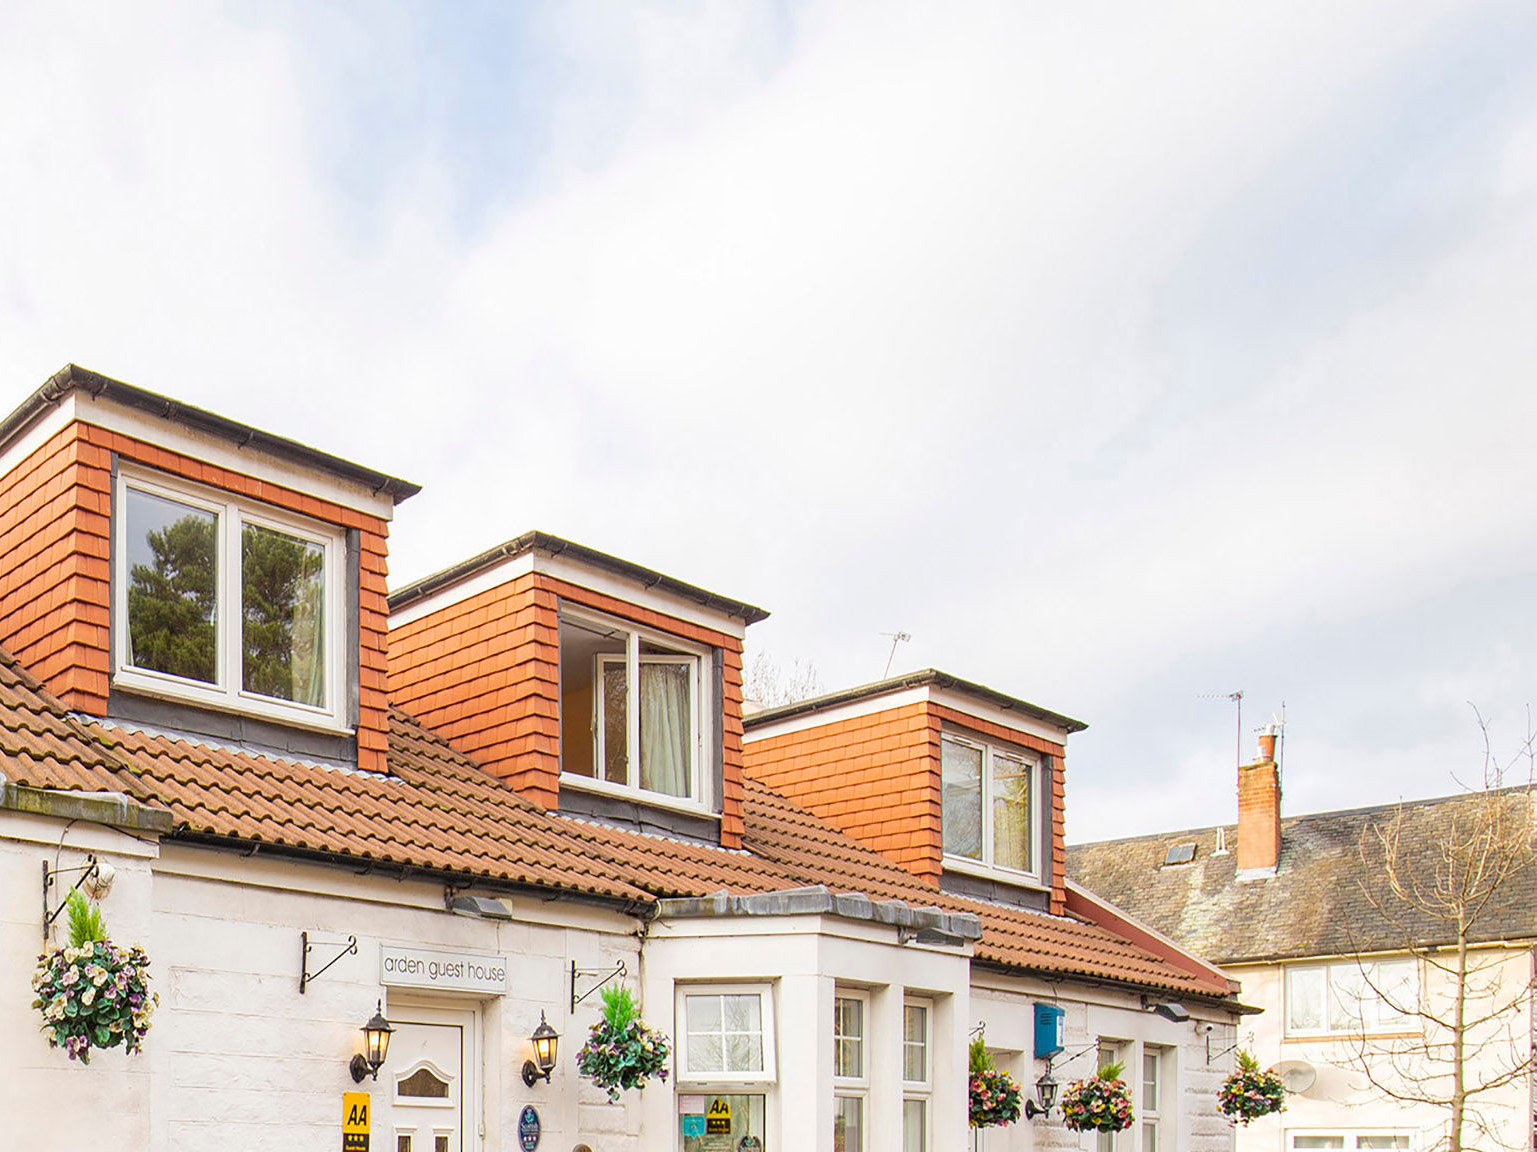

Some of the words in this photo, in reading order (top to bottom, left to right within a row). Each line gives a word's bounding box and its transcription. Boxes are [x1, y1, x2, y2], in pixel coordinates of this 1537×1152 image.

[384, 956, 425, 974] arden
[428, 961, 464, 980] guest
[468, 962, 505, 982] house
[347, 1104, 367, 1126] AA
[709, 1098, 729, 1114] AA
